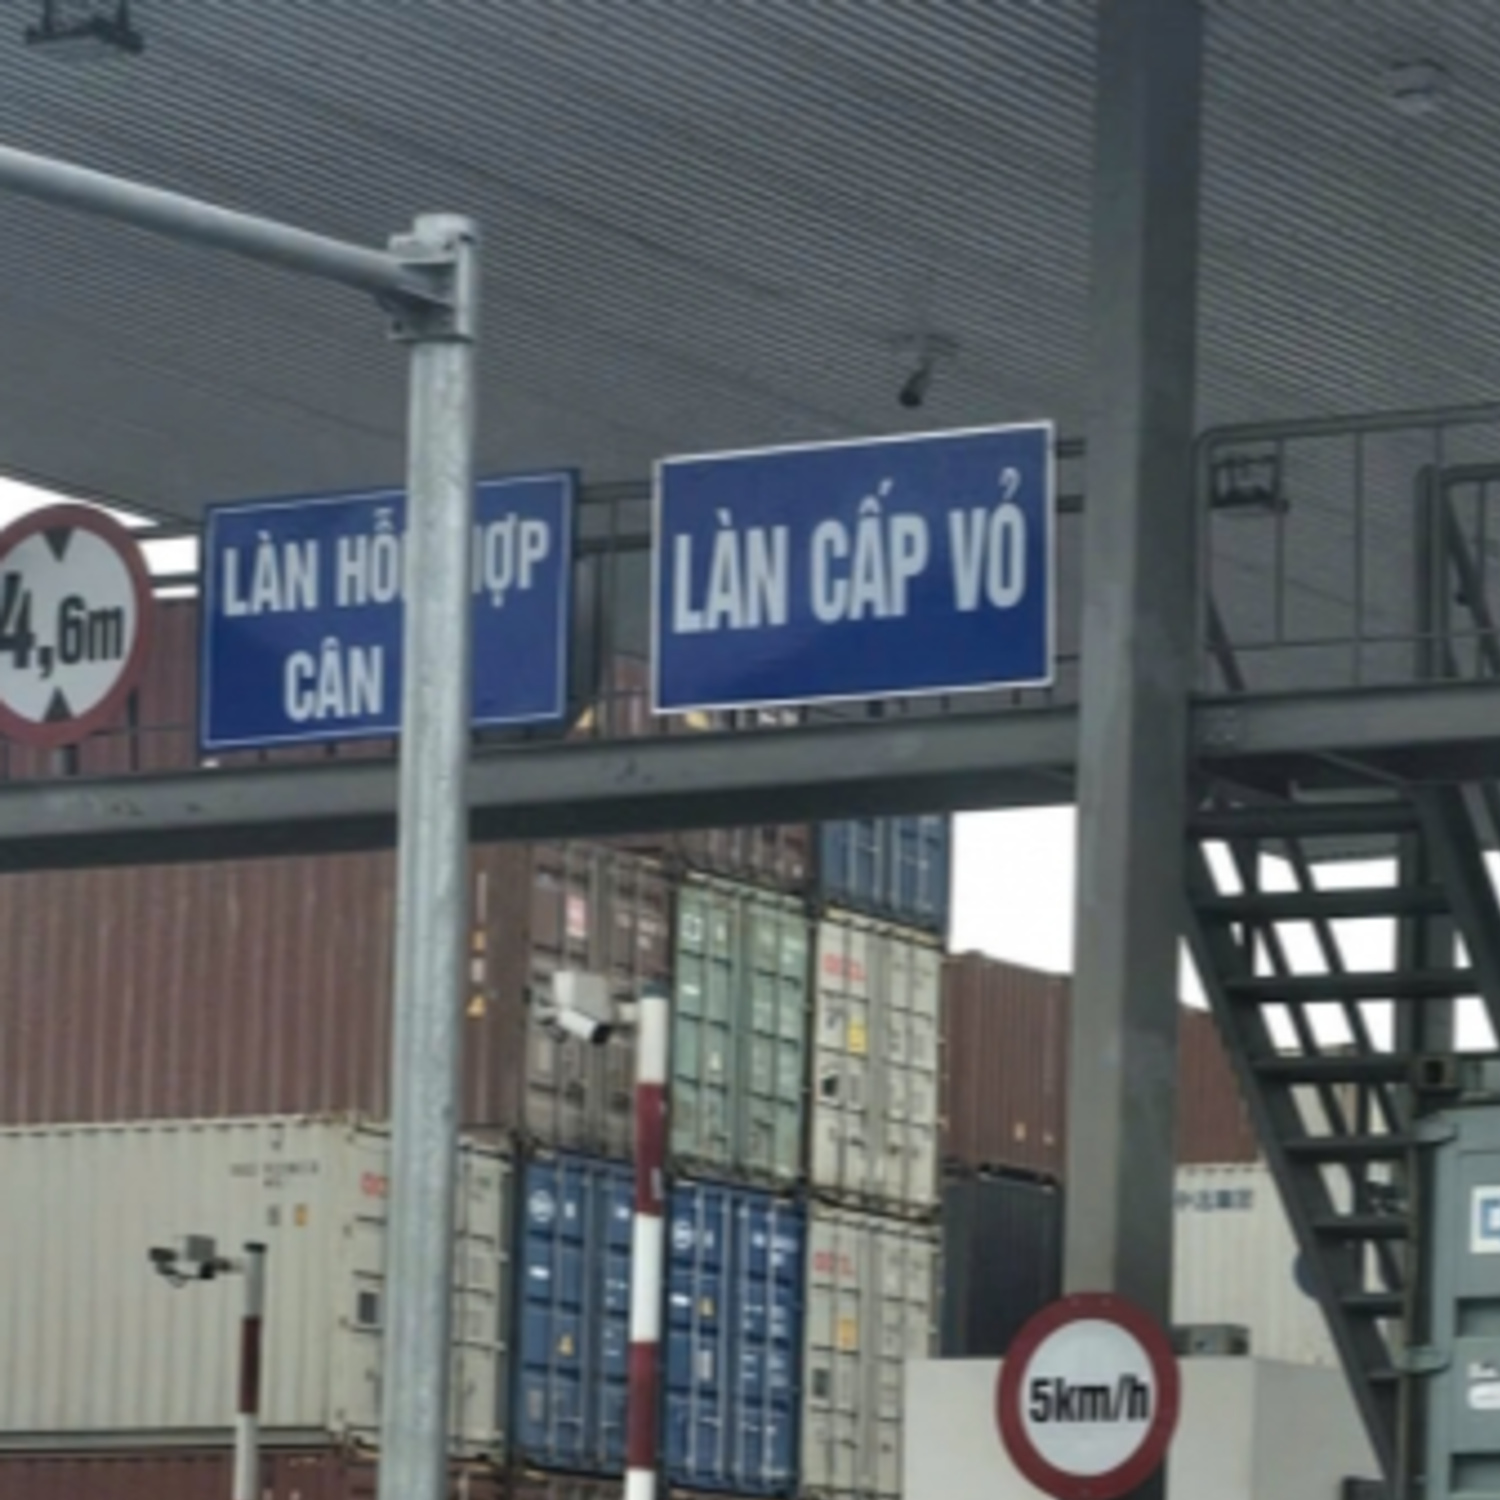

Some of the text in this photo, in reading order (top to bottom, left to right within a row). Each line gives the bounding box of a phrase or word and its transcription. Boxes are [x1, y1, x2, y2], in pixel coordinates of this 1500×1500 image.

[223, 529, 319, 617] LÀN
[337, 508, 408, 607] HỖ
[673, 467, 1026, 634] LÀN CẤP VỎ
[0, 571, 125, 681] 4,6m
[284, 636, 384, 722] CÂN
[1029, 1373, 1150, 1424] 5km/h
